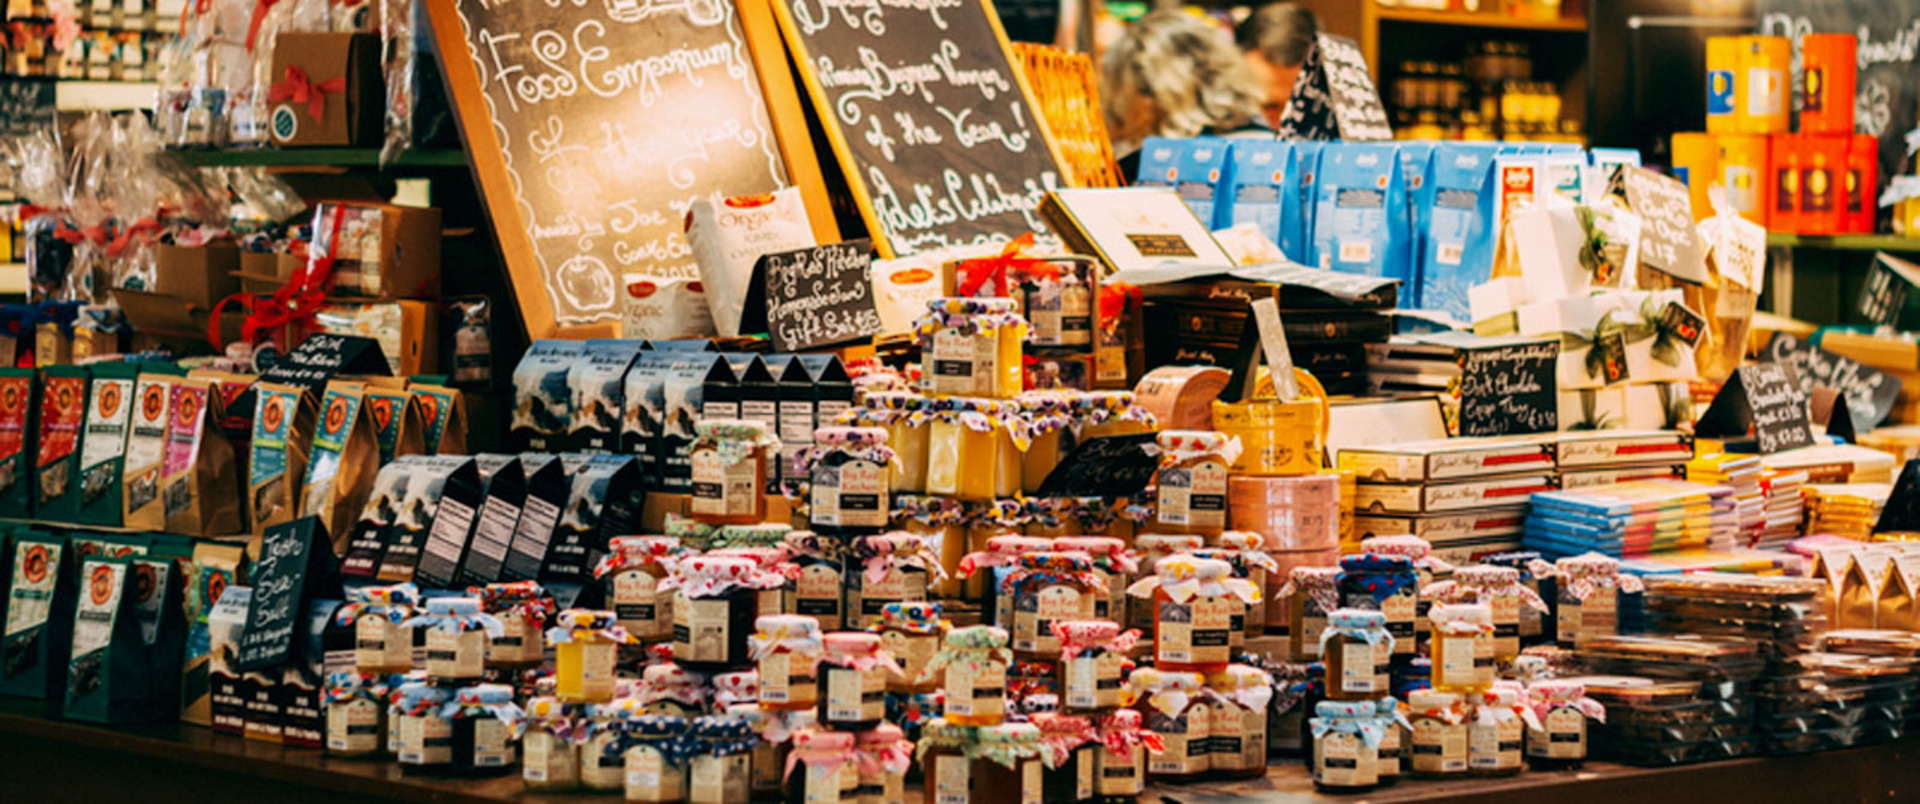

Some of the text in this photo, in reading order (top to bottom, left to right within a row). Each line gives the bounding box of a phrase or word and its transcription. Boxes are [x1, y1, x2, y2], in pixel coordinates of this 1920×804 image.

[573, 20, 743, 107] Emporium
[865, 114, 896, 162] of
[894, 111, 943, 146] the
[608, 199, 668, 233] Joe
[779, 315, 824, 350] Gift
[823, 310, 856, 338] Set
[860, 469, 878, 481] Red
